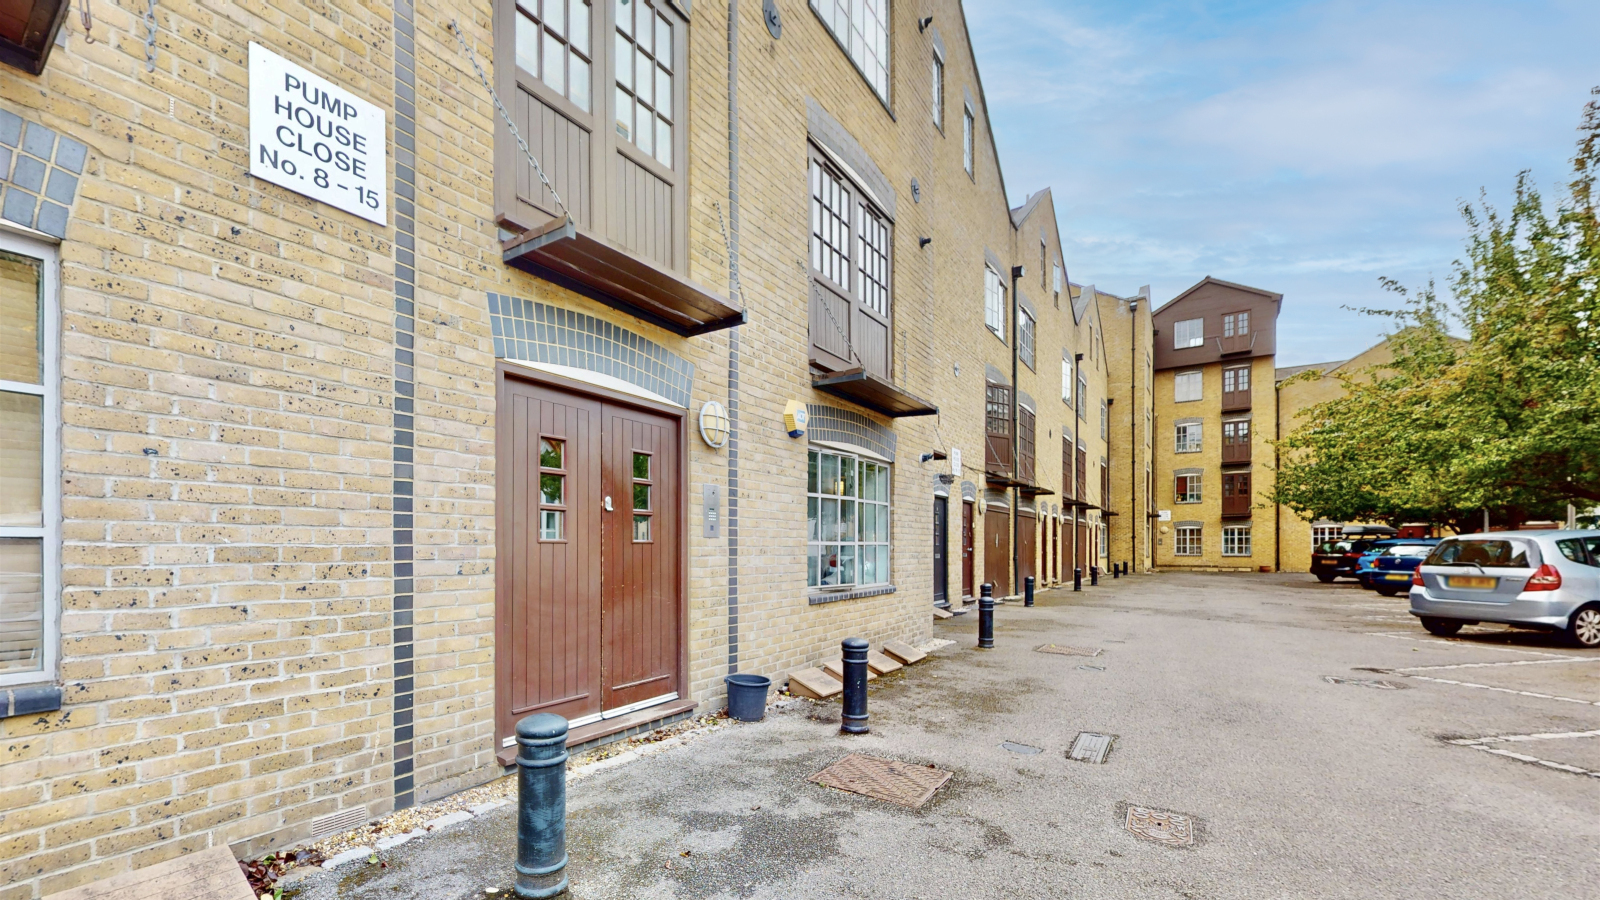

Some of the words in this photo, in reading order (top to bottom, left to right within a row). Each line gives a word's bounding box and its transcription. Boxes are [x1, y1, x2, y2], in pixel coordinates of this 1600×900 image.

[285, 72, 358, 121] PUMP
[274, 94, 367, 155] HOUSE
[276, 125, 367, 180] CLOSE
